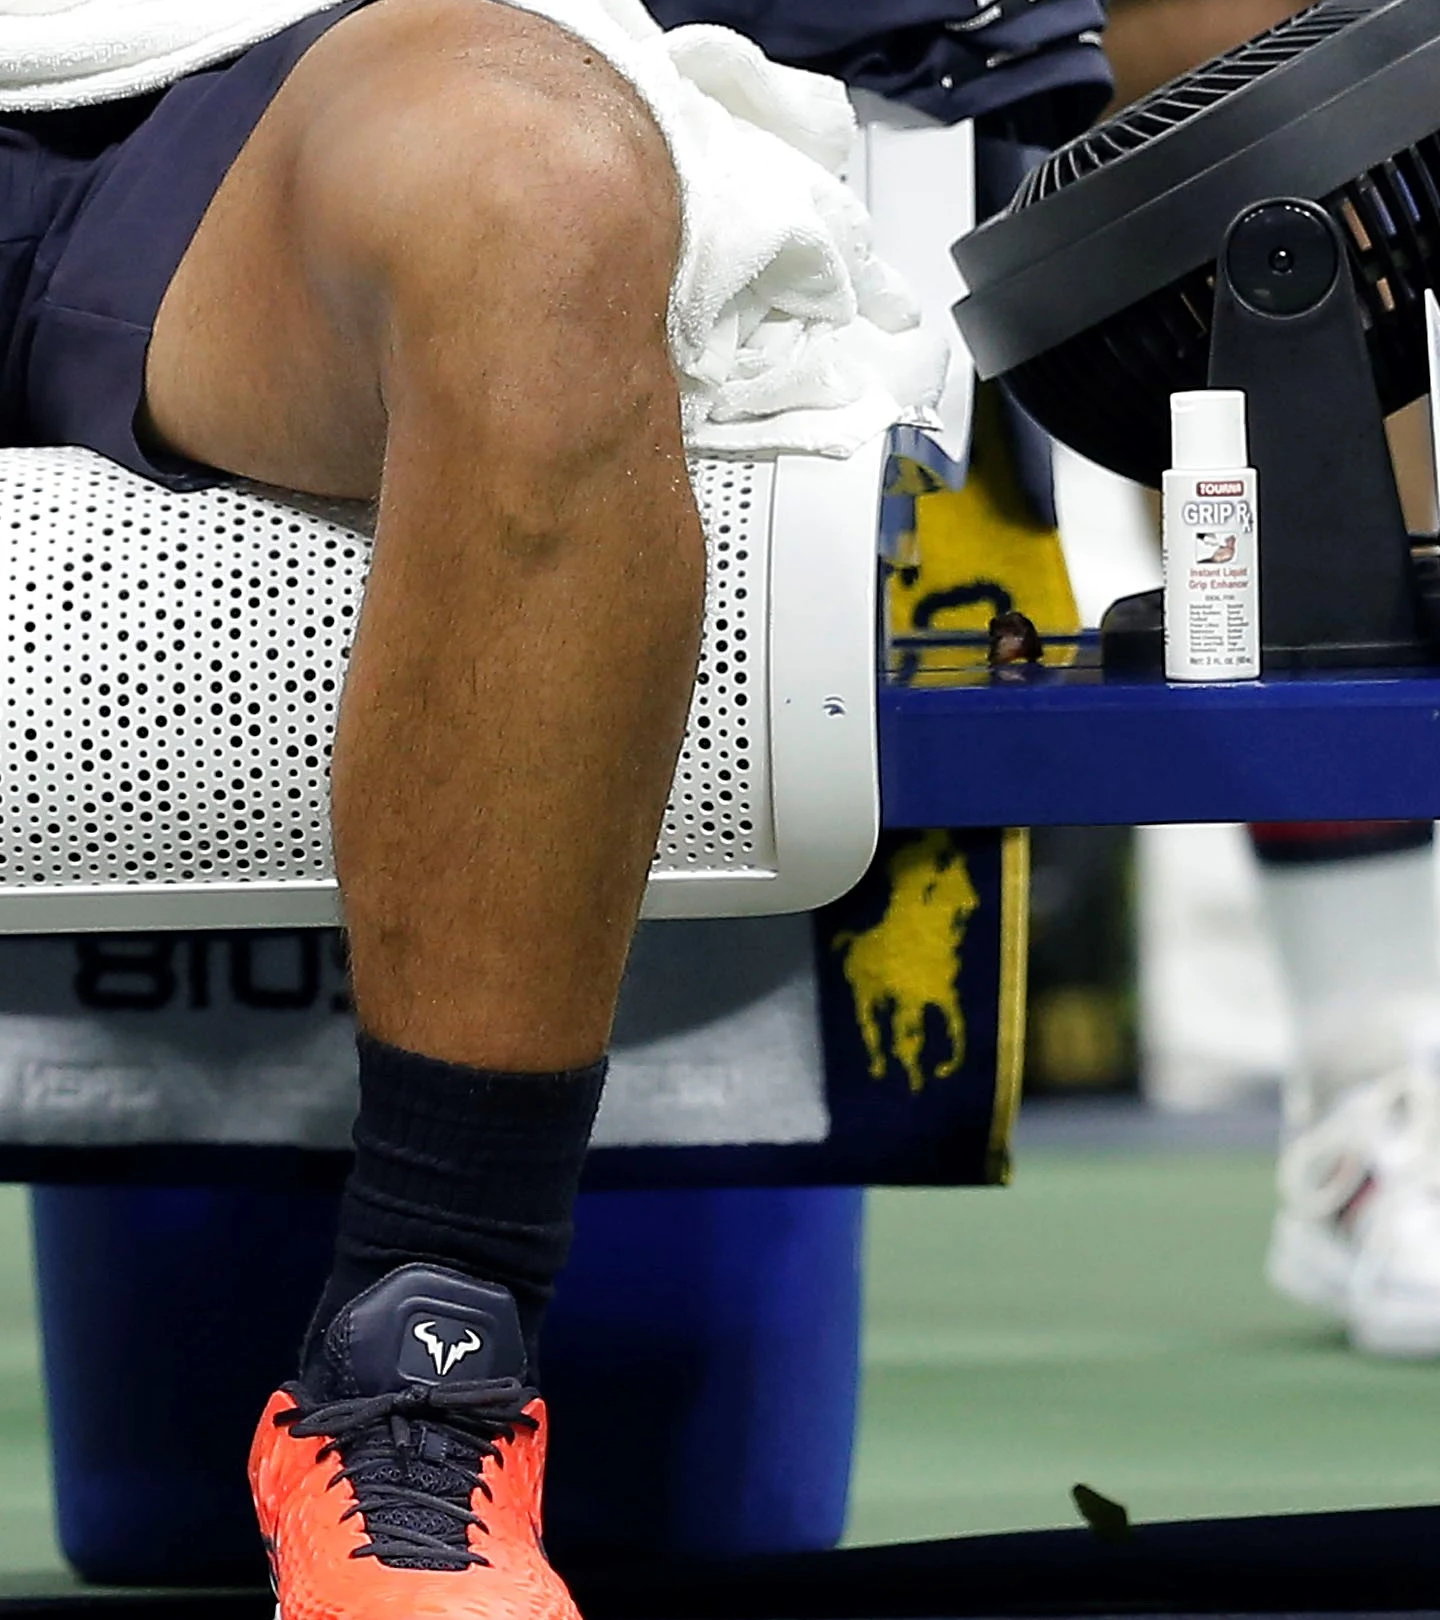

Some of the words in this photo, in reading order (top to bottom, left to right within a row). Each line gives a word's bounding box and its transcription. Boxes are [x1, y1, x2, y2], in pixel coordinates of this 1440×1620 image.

[1183, 502, 1233, 525] GRIP
[1189, 567, 1221, 577] Instant
[1223, 567, 1248, 578] Liquid
[1188, 580, 1208, 591] Grip
